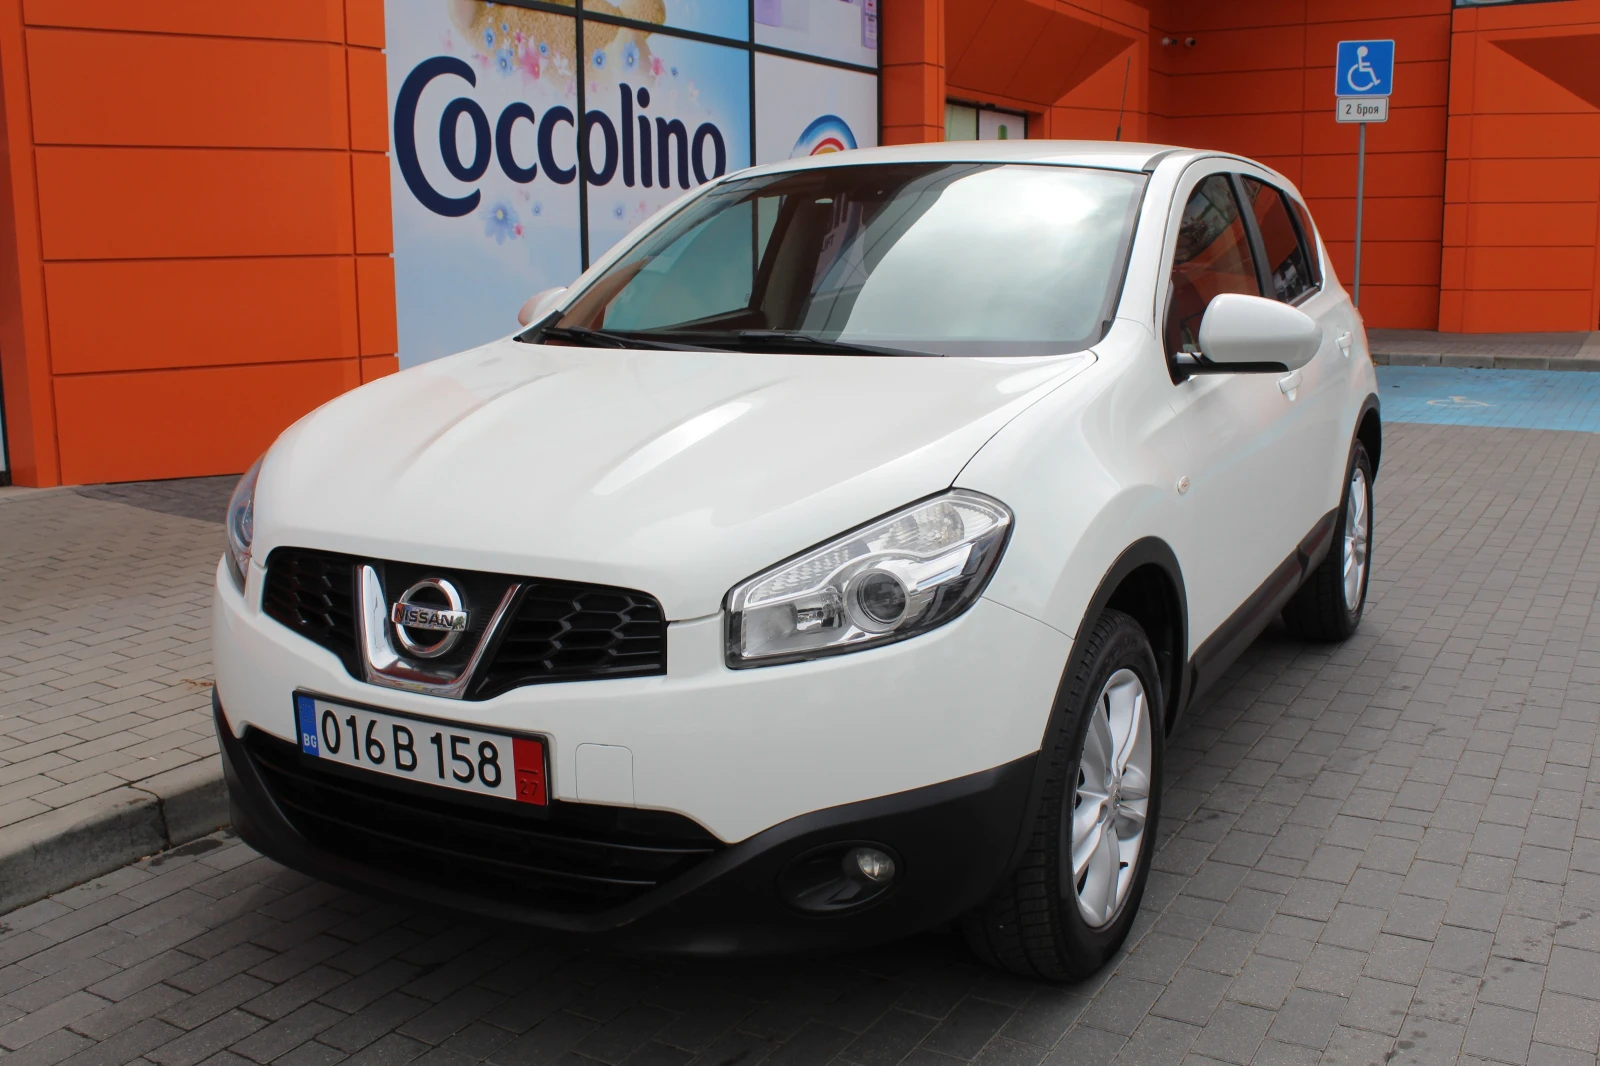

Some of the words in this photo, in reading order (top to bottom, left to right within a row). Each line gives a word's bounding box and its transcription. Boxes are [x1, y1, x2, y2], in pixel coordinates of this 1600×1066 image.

[1345, 104, 1352, 115] 2
[1357, 103, 1379, 117] броя
[393, 56, 727, 217] Coccolino
[395, 606, 456, 630] NISSAN
[303, 732, 318, 749] BG
[519, 779, 538, 797] 27
